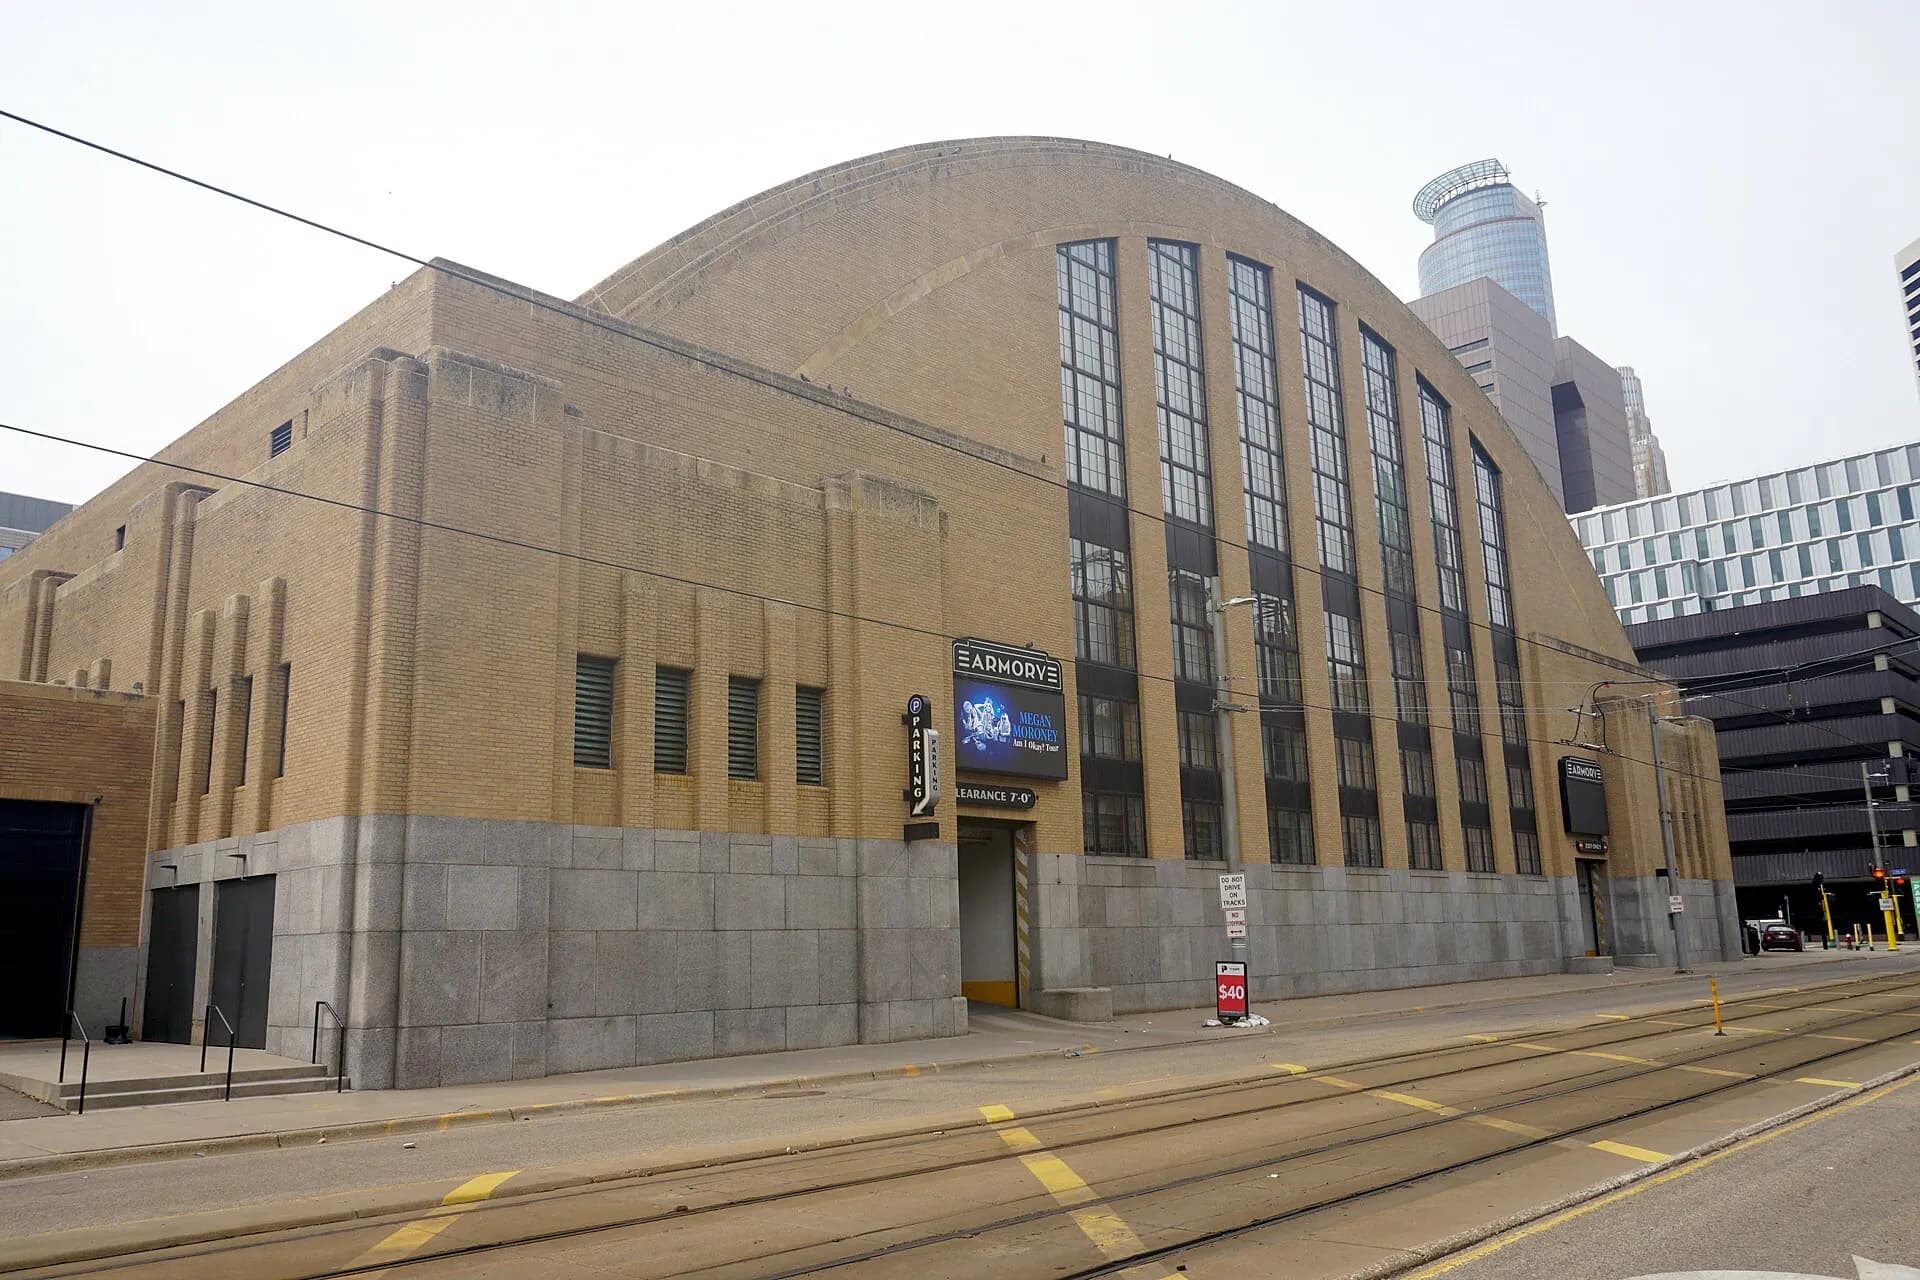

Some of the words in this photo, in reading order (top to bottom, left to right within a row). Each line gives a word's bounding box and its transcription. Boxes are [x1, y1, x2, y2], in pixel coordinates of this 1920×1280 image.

[971, 653, 1046, 681] ARMORY
[1019, 711, 1052, 728] MEGAN
[1012, 724, 1058, 743] MORONEY
[1012, 738, 1023, 747] Am
[912, 716, 922, 798] PARKING
[1572, 764, 1597, 779] ARMORY
[955, 788, 1007, 801] LEARANCE
[1219, 983, 1245, 1000] $40
